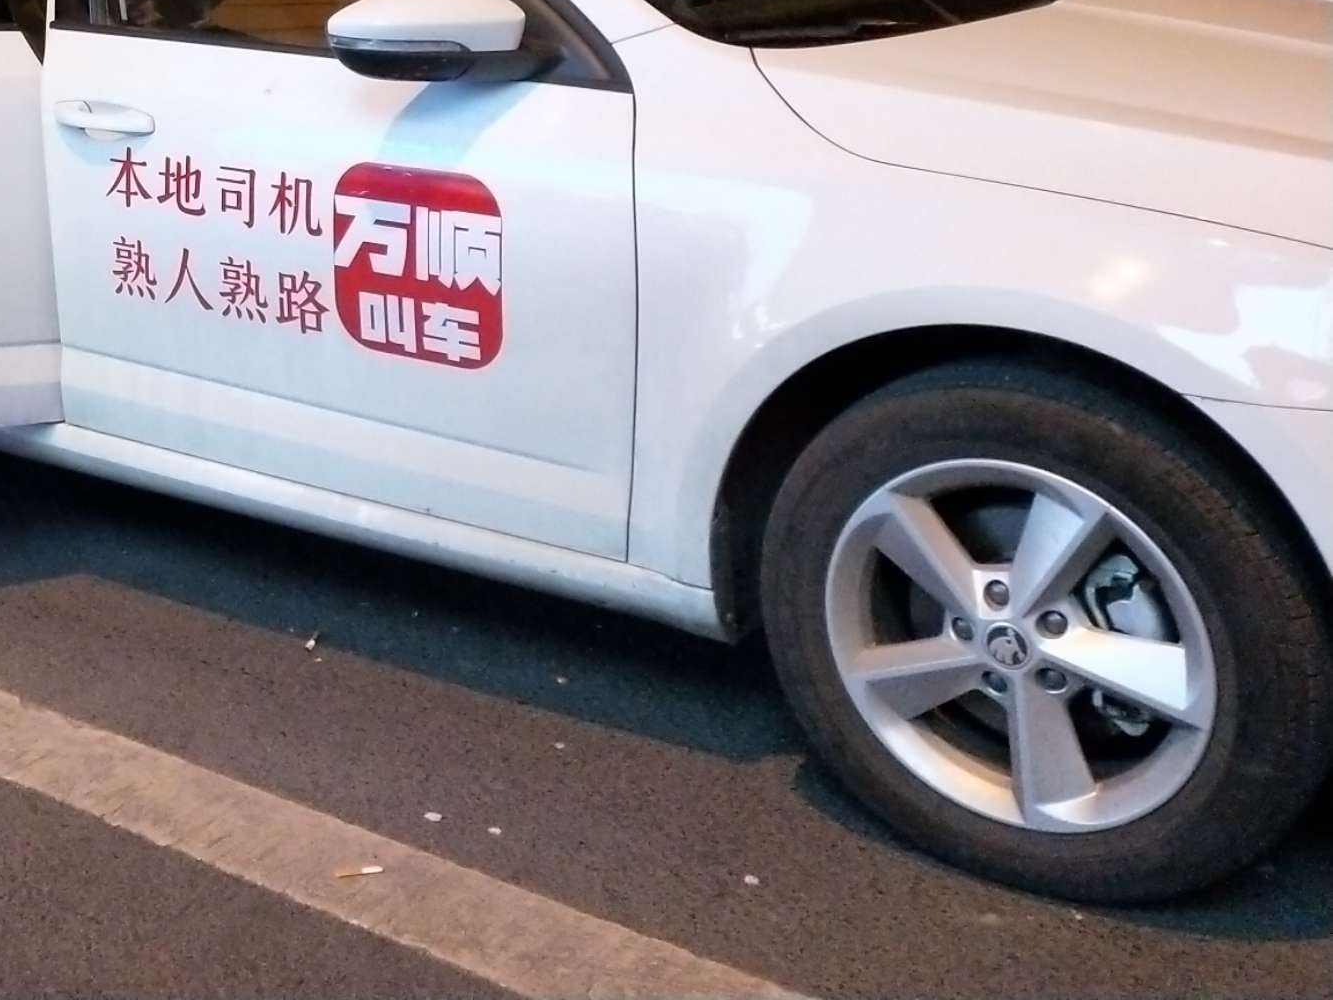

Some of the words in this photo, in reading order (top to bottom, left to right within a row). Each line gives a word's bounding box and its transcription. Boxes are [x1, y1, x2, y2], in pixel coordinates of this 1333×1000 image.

[106, 147, 323, 237] 本地司机
[112, 236, 329, 335] 熟人熟路
[334, 194, 502, 296] 万顺
[358, 291, 481, 363] 叫车
